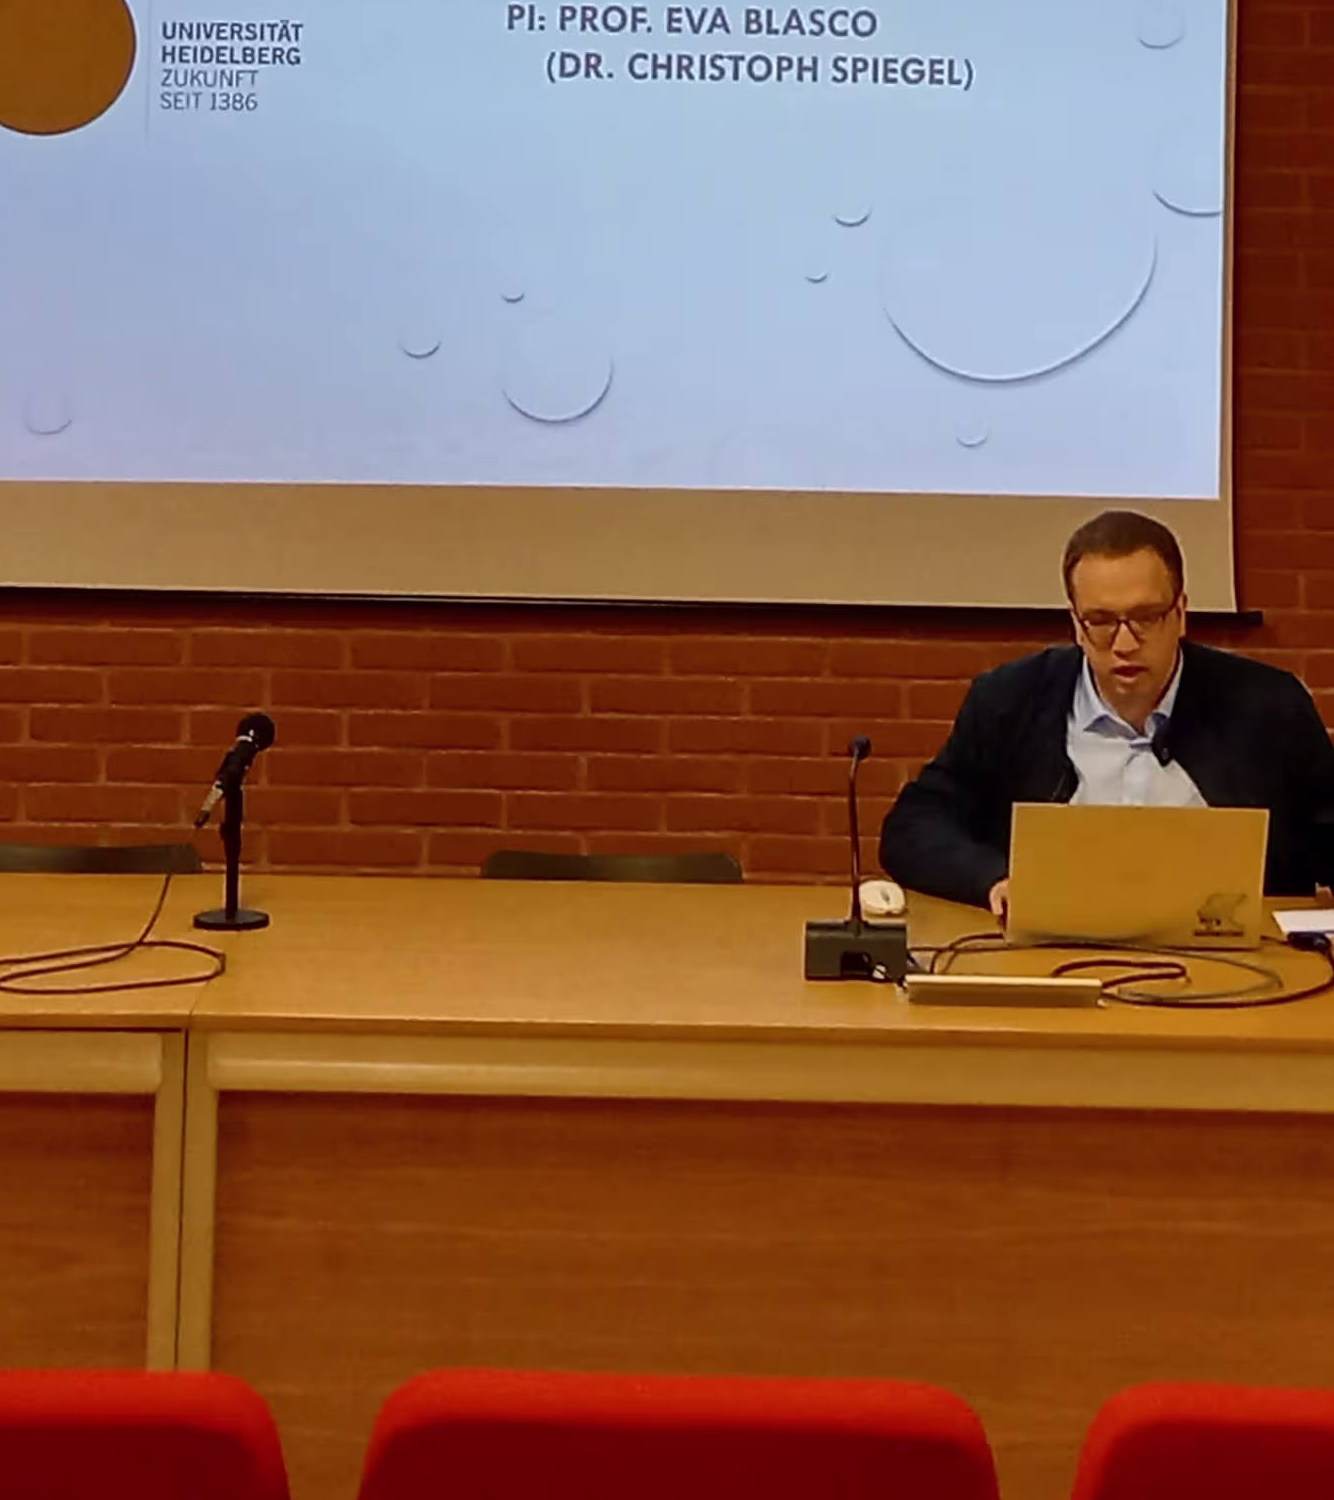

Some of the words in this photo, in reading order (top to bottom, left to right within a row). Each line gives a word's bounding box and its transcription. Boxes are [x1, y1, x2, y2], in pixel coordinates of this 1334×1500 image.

[162, 19, 304, 42] UNIVERSITÄT
[507, 3, 546, 32] PI:
[559, 5, 653, 34] PROF.
[667, 6, 731, 35] EVA
[744, 8, 877, 38] BLASCO
[161, 45, 301, 66] HEIDELBERG
[161, 68, 260, 88] ZUKUNFT
[546, 51, 614, 84] (DR.
[627, 52, 819, 83] CHRISTOPH
[831, 55, 974, 92] SPIEGEL)
[160, 91, 203, 111] SEIT
[209, 92, 259, 112] 1386
